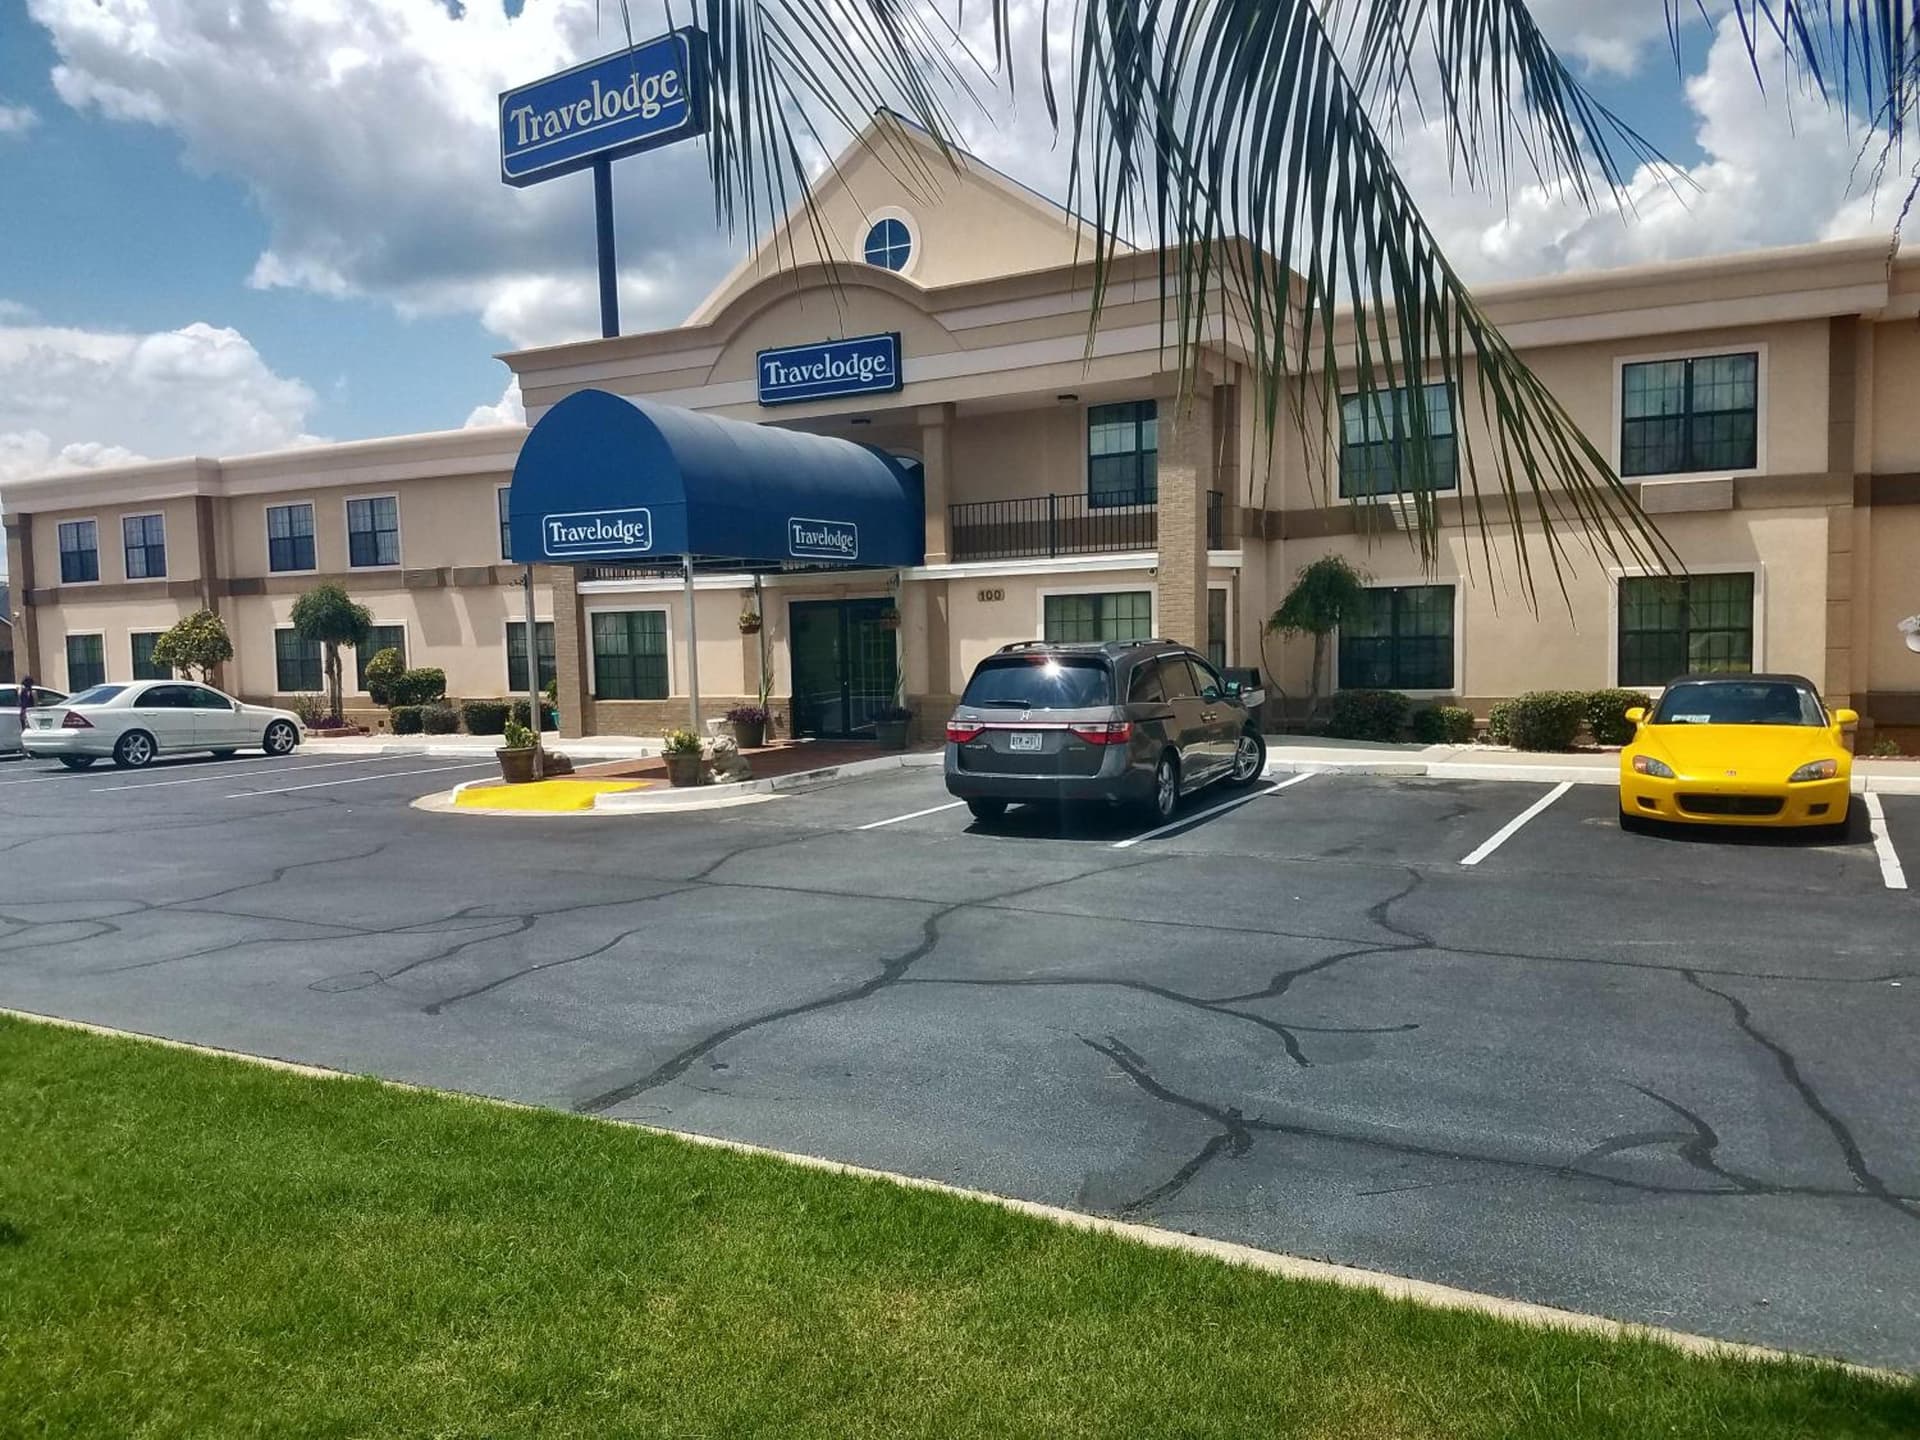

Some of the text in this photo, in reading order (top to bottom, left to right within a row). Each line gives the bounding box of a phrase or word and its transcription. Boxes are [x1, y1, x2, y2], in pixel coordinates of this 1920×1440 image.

[510, 69, 678, 145] Travelodge
[764, 353, 886, 385] Travelodge
[549, 519, 644, 544] Travelodge
[793, 525, 854, 552] Travelodge
